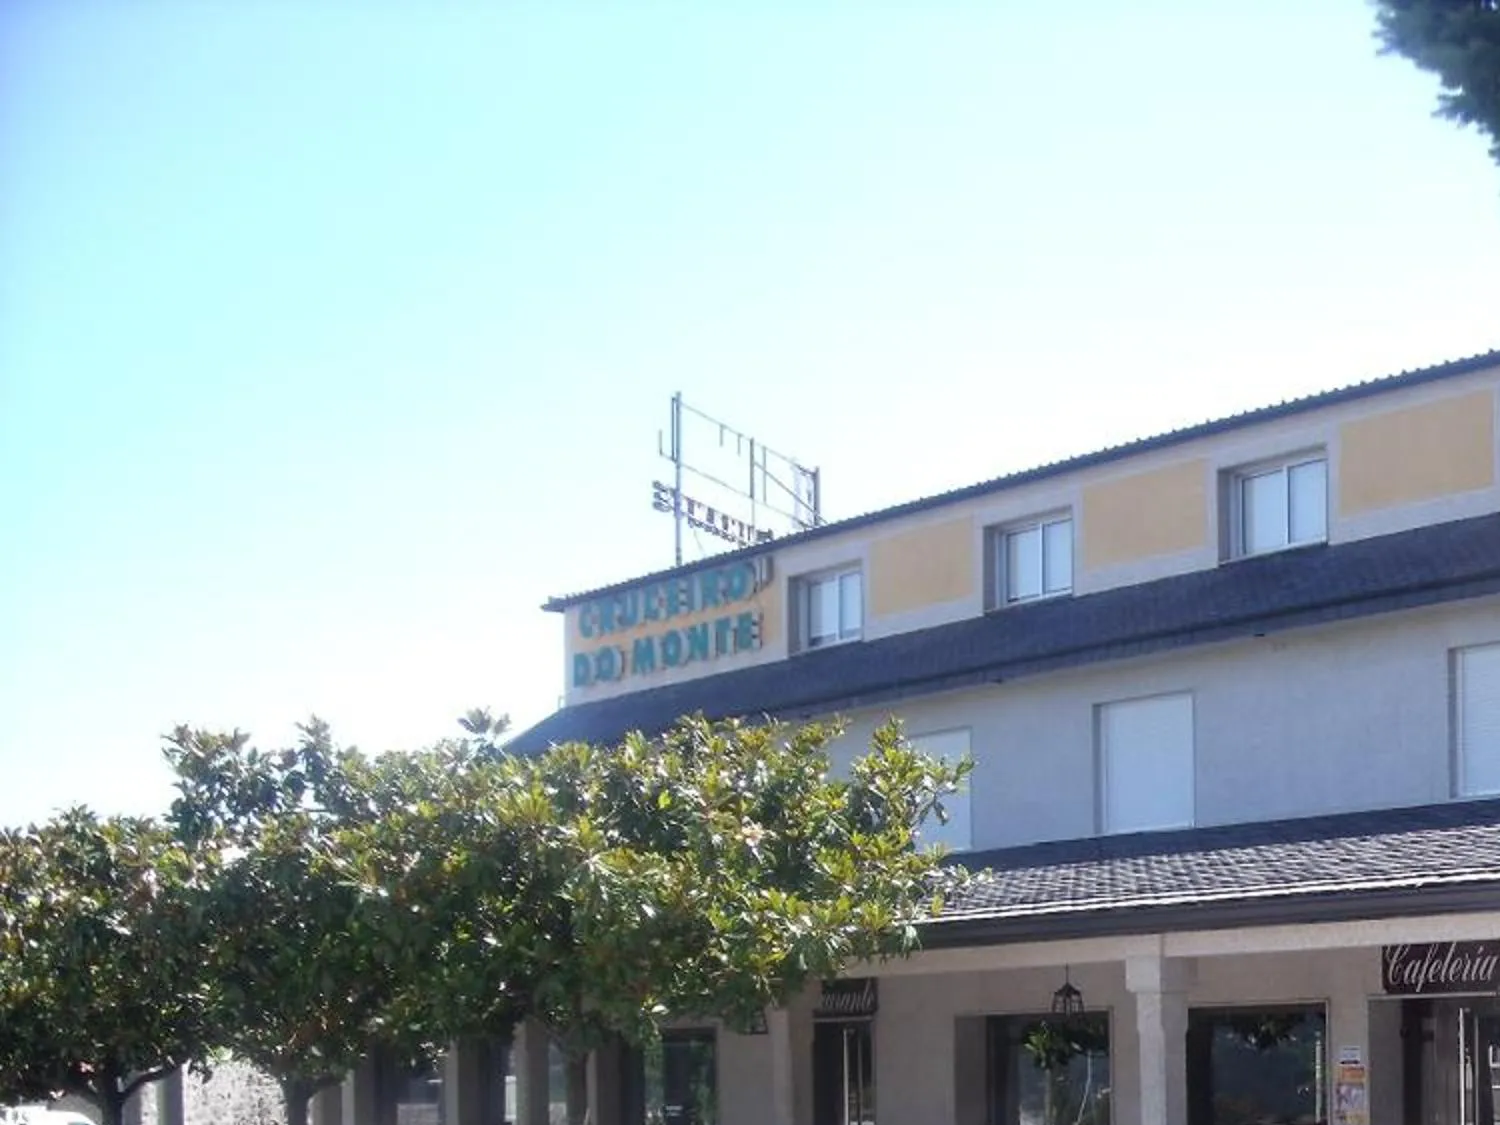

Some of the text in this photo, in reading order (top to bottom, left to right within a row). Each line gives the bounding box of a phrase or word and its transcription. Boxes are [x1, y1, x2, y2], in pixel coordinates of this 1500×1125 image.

[578, 561, 760, 639] CRUCEIRO
[573, 611, 760, 688] DO MONTE
